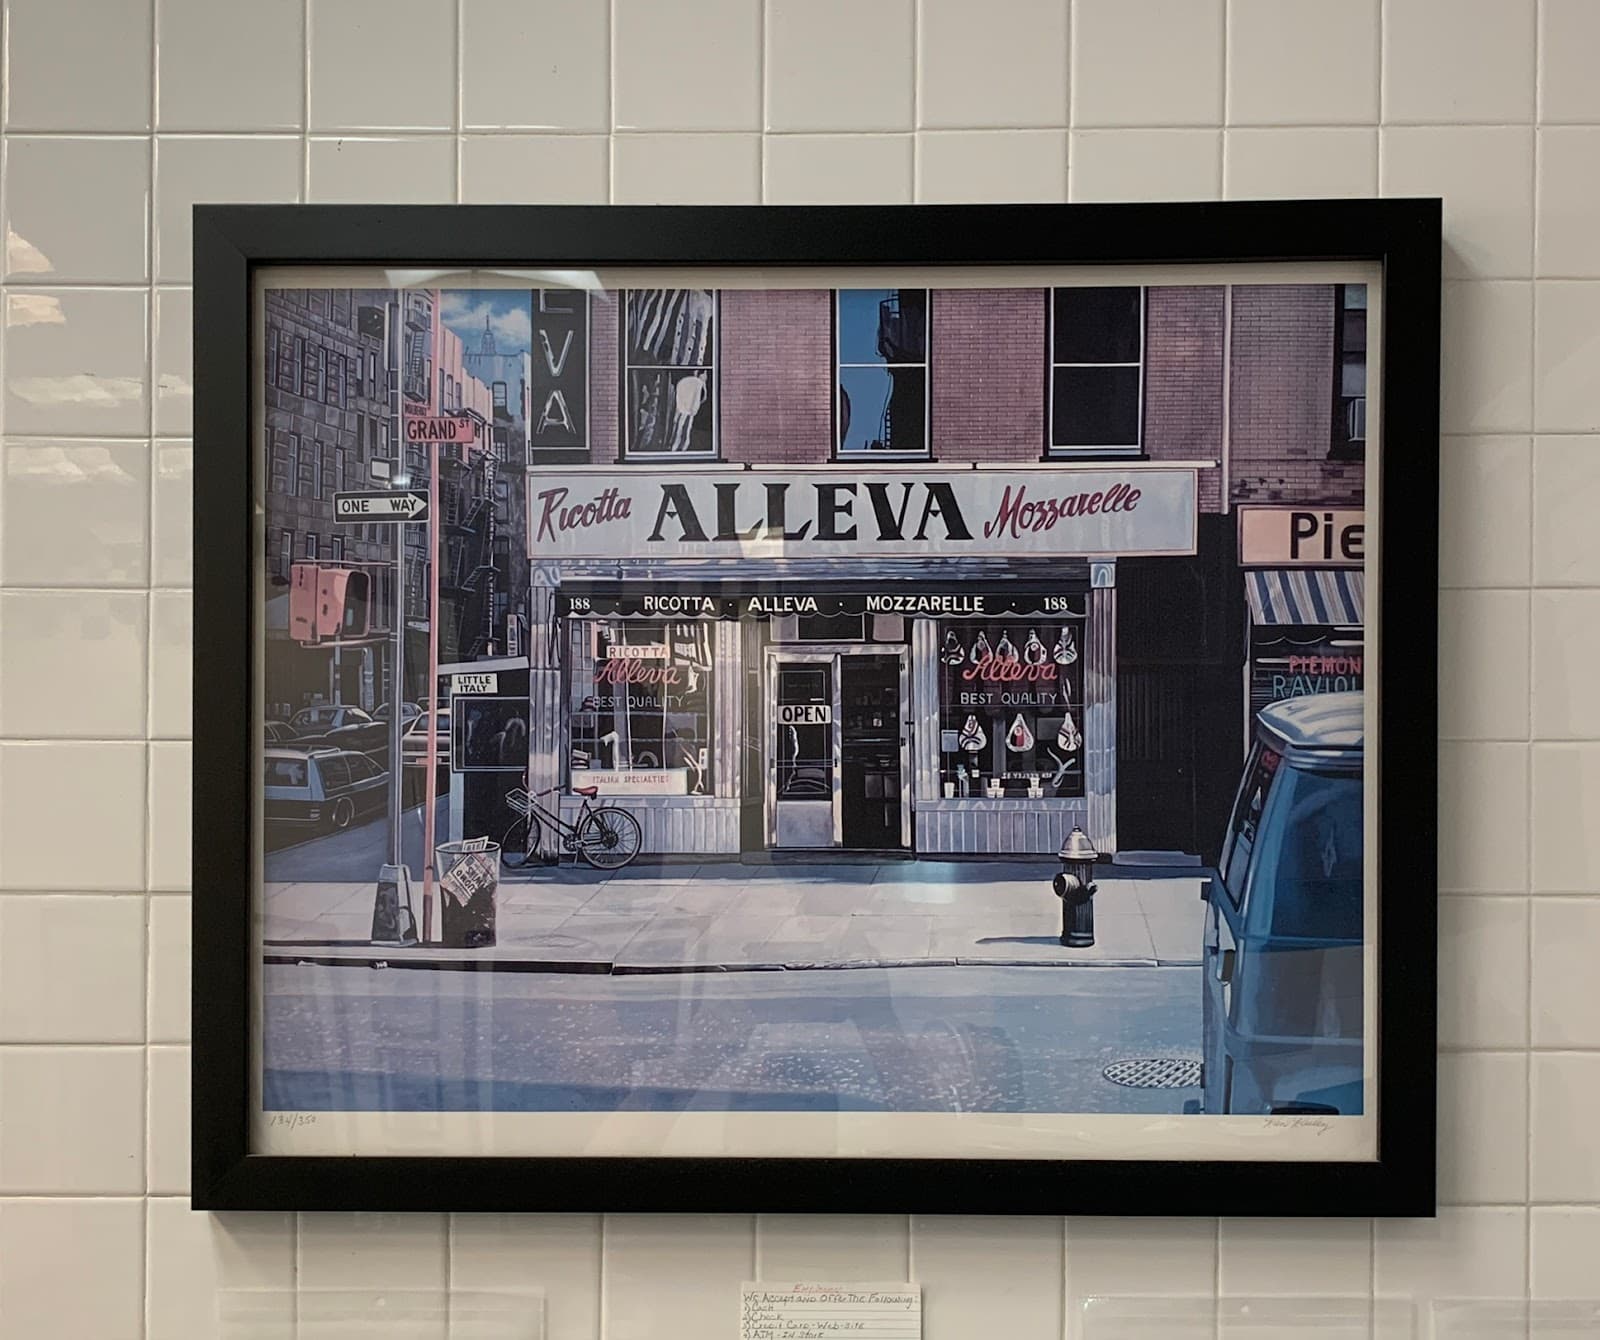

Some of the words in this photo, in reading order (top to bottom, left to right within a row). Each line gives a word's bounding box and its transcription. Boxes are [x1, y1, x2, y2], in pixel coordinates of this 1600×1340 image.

[407, 420, 457, 440] GRAND
[341, 499, 370, 513] ONE
[391, 498, 417, 512] WAY
[537, 486, 632, 543] Ricotta
[646, 482, 975, 541] ALLEVA
[984, 483, 1141, 539] Mozzarelle
[569, 597, 591, 610] 188
[643, 595, 716, 612] RICOTTA
[747, 595, 819, 612] ALLEVA
[865, 595, 985, 612] MOZZARELLE
[1043, 596, 1069, 611] 188
[608, 646, 670, 658] RICOTTA
[592, 657, 682, 685] Alleva
[962, 654, 1058, 682] Alleva
[457, 675, 492, 685] LITTLE
[460, 684, 488, 693] ITALY
[592, 695, 622, 708] BEST
[627, 695, 684, 709] QUALITY
[960, 692, 994, 705] BEST
[1001, 692, 1058, 706] QUALITY
[782, 706, 827, 723] OPEN
